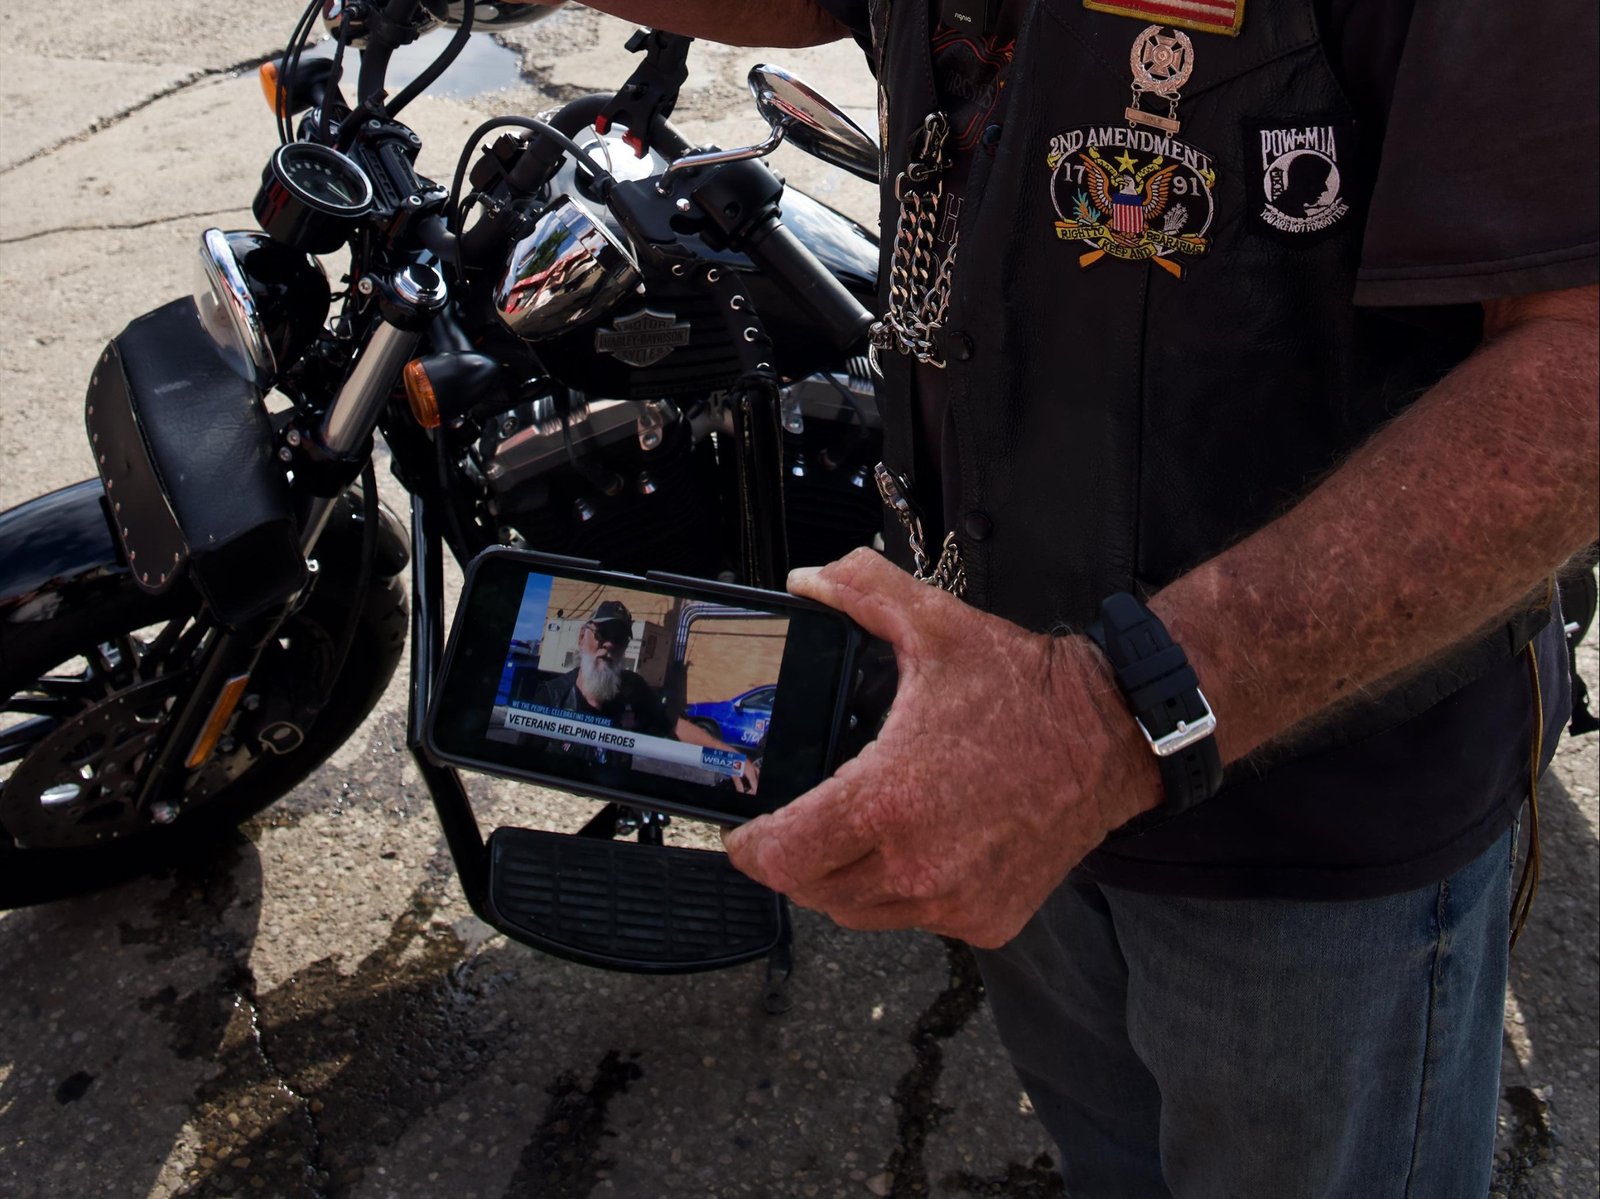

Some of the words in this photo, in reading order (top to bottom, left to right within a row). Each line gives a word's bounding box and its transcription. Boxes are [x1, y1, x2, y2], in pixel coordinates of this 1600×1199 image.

[1050, 129, 1084, 156] 2ND
[1086, 127, 1213, 173] AMENDMENT
[1260, 128, 1297, 171] POW
[1305, 126, 1337, 162] MIA
[1260, 208, 1275, 224] YOU
[1272, 219, 1289, 231] ARE
[1288, 223, 1306, 233] NOT
[1306, 203, 1350, 233] FORGOTTEN
[1061, 228, 1090, 239] RIGHT
[1102, 240, 1128, 257] KEEP
[1130, 247, 1152, 259] AND
[602, 332, 683, 348] HARLEY-DAVIDSON
[512, 700, 520, 709] WE
[521, 701, 530, 711] THE
[551, 707, 584, 721] CELEBRATING
[595, 715, 611, 727] YEARS
[509, 714, 556, 733] VETERANS
[557, 724, 597, 741] HELPING
[598, 732, 636, 749] HEROES
